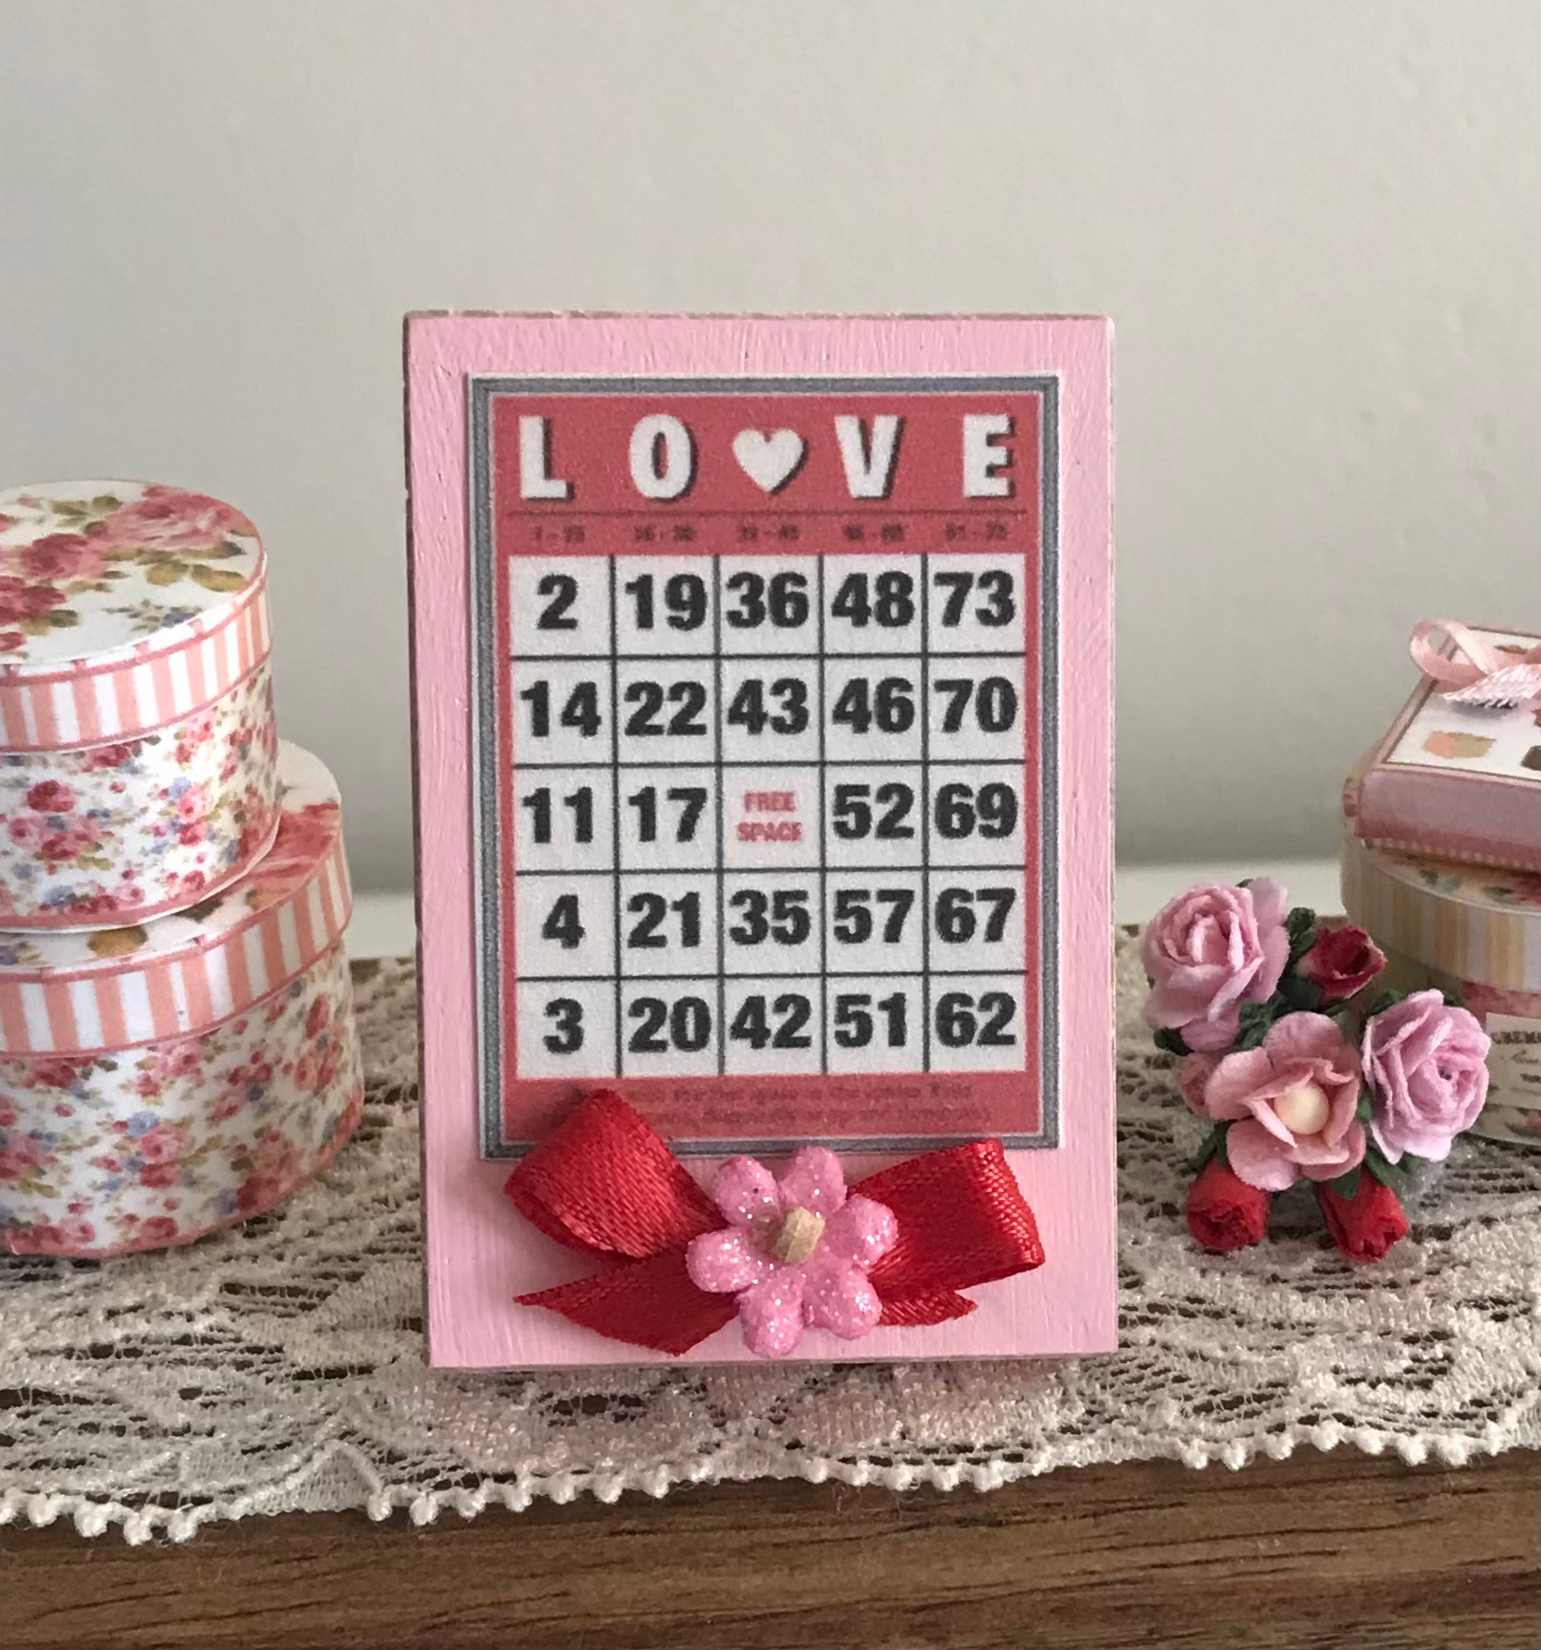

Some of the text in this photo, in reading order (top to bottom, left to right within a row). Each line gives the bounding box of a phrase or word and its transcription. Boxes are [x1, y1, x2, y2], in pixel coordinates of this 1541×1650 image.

[518, 414, 1014, 499] L O V E
[537, 570, 1015, 631] 2 19 36 48 73
[521, 677, 1017, 737] 14 22 43 46 70
[523, 783, 1018, 843] 11 17 52 69
[737, 821, 803, 842] SPACE
[743, 791, 796, 812] FREE
[543, 888, 1016, 949] 4 21 35 57 67
[543, 992, 1016, 1054] 3 20 42 51 62
